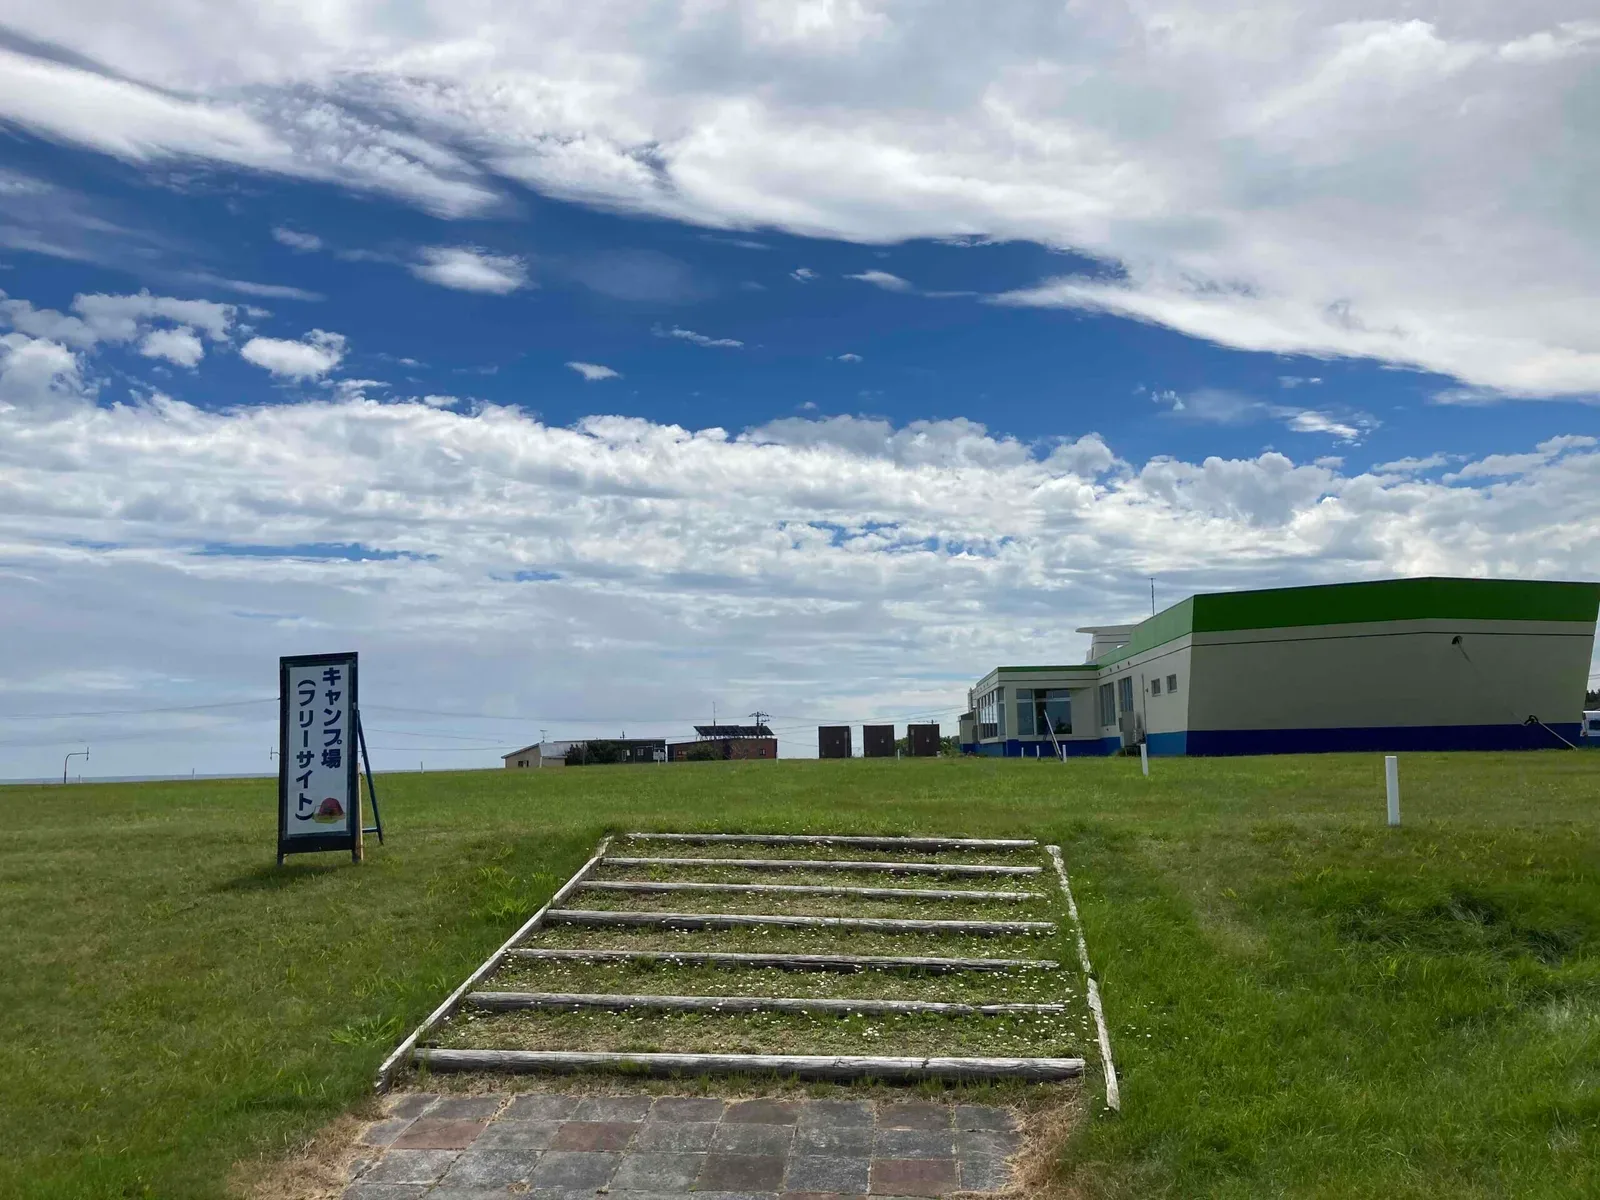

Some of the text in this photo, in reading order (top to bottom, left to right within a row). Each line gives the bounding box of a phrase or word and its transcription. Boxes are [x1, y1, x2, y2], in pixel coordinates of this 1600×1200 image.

[321, 667, 342, 768] キャンプ場
